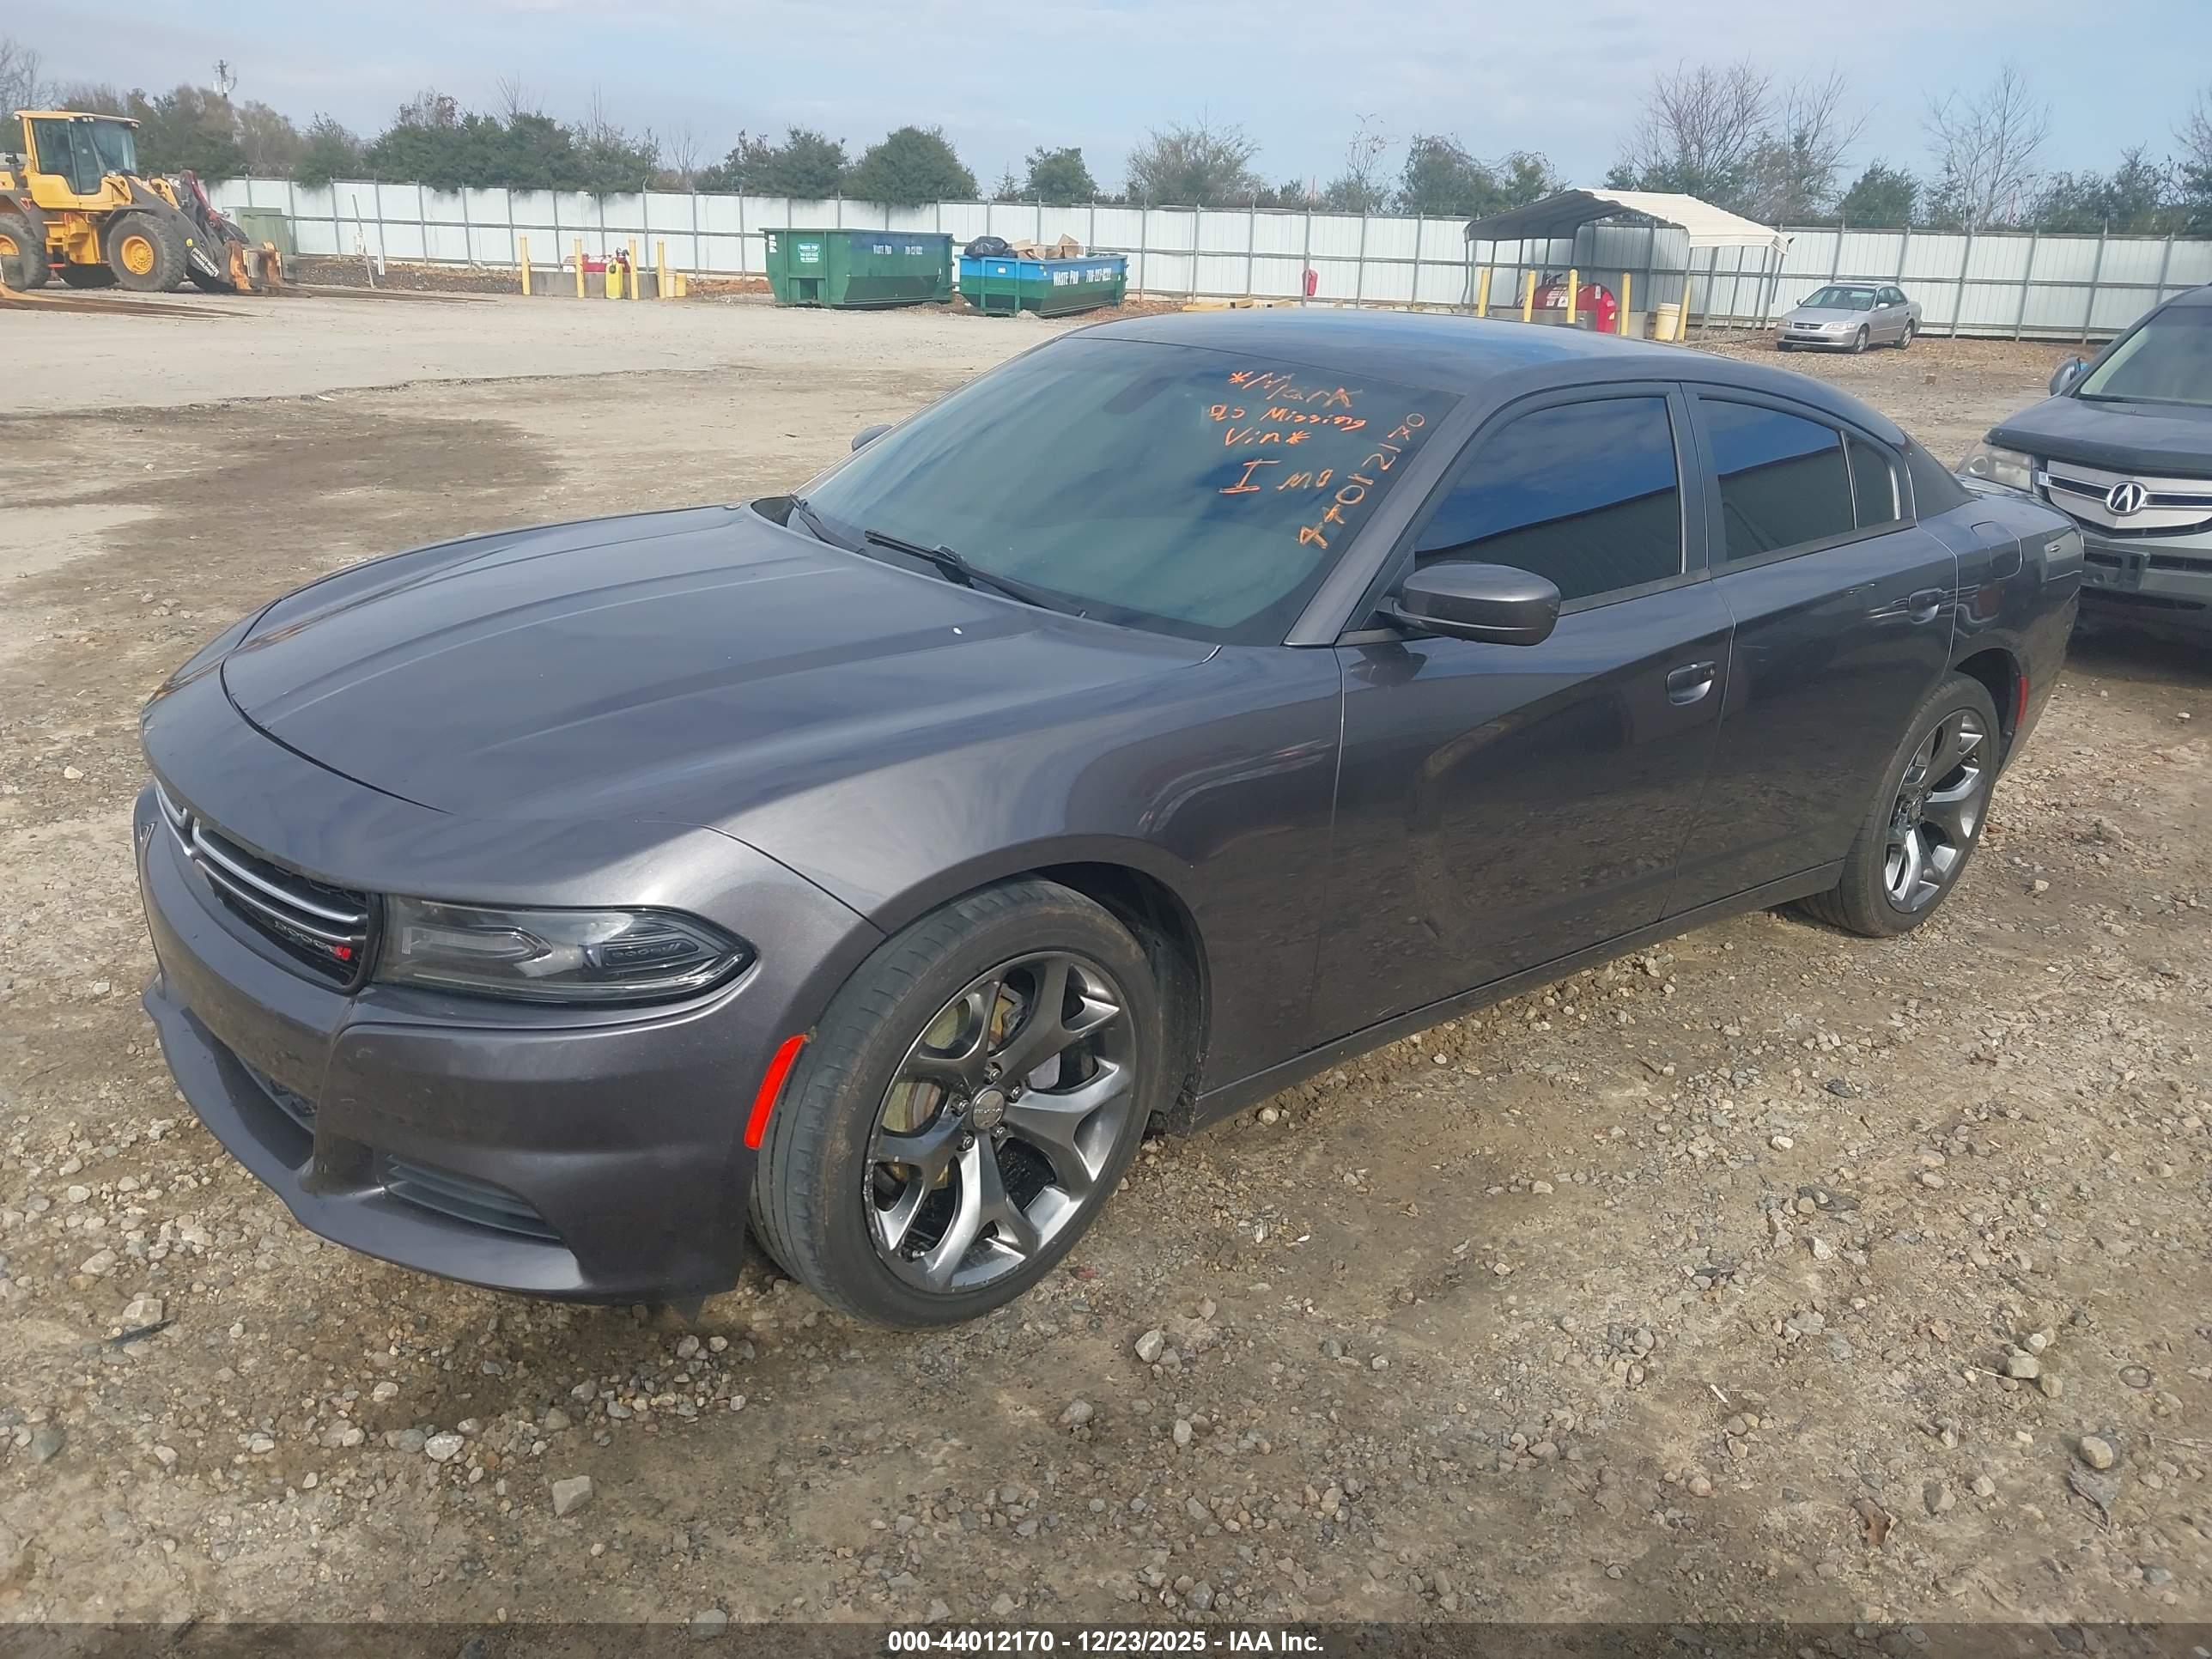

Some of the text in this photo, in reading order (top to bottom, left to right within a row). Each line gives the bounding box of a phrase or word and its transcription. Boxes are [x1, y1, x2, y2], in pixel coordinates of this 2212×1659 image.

[1053, 270, 1079, 287] WASTE PRO
[1260, 406, 1367, 431] Missing
